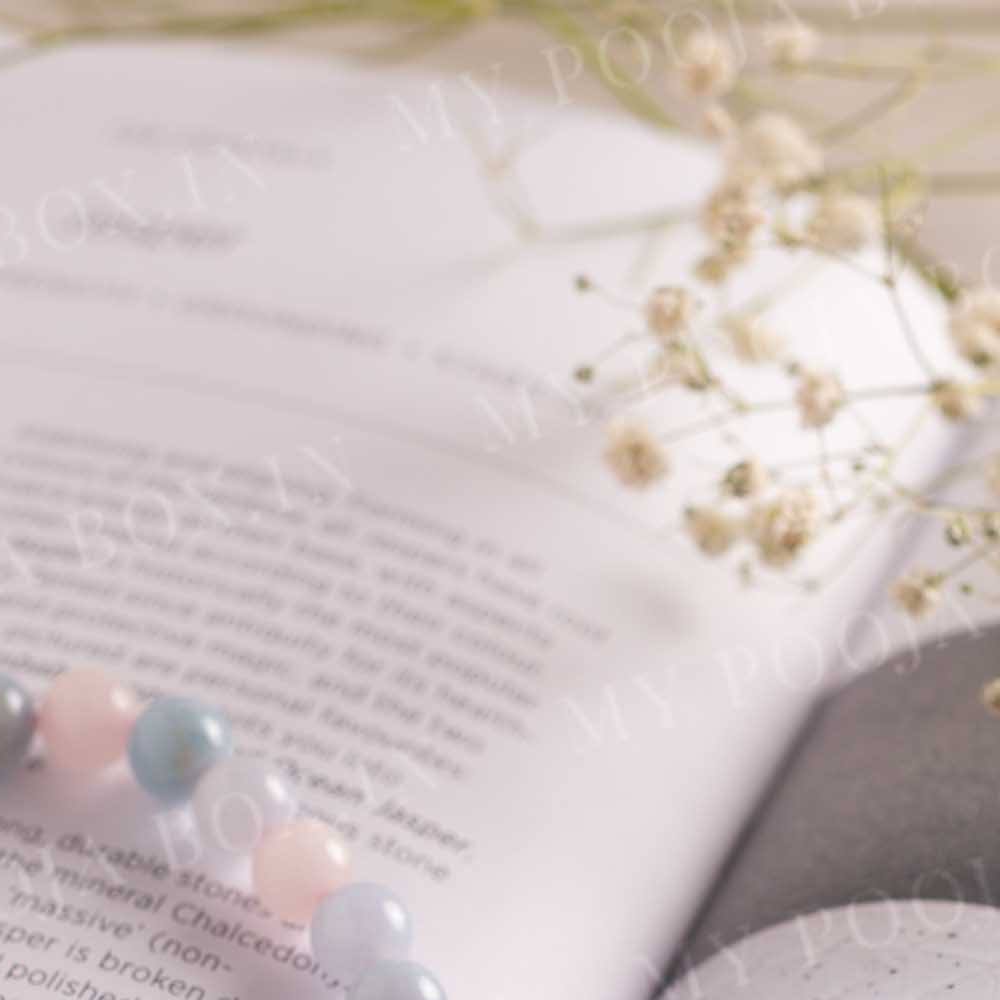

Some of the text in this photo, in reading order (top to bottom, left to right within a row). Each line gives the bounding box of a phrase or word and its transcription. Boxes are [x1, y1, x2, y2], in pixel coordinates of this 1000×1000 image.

[53, 865, 168, 914] mineral
[65, 937, 90, 964] is
[147, 931, 234, 973] (non-
